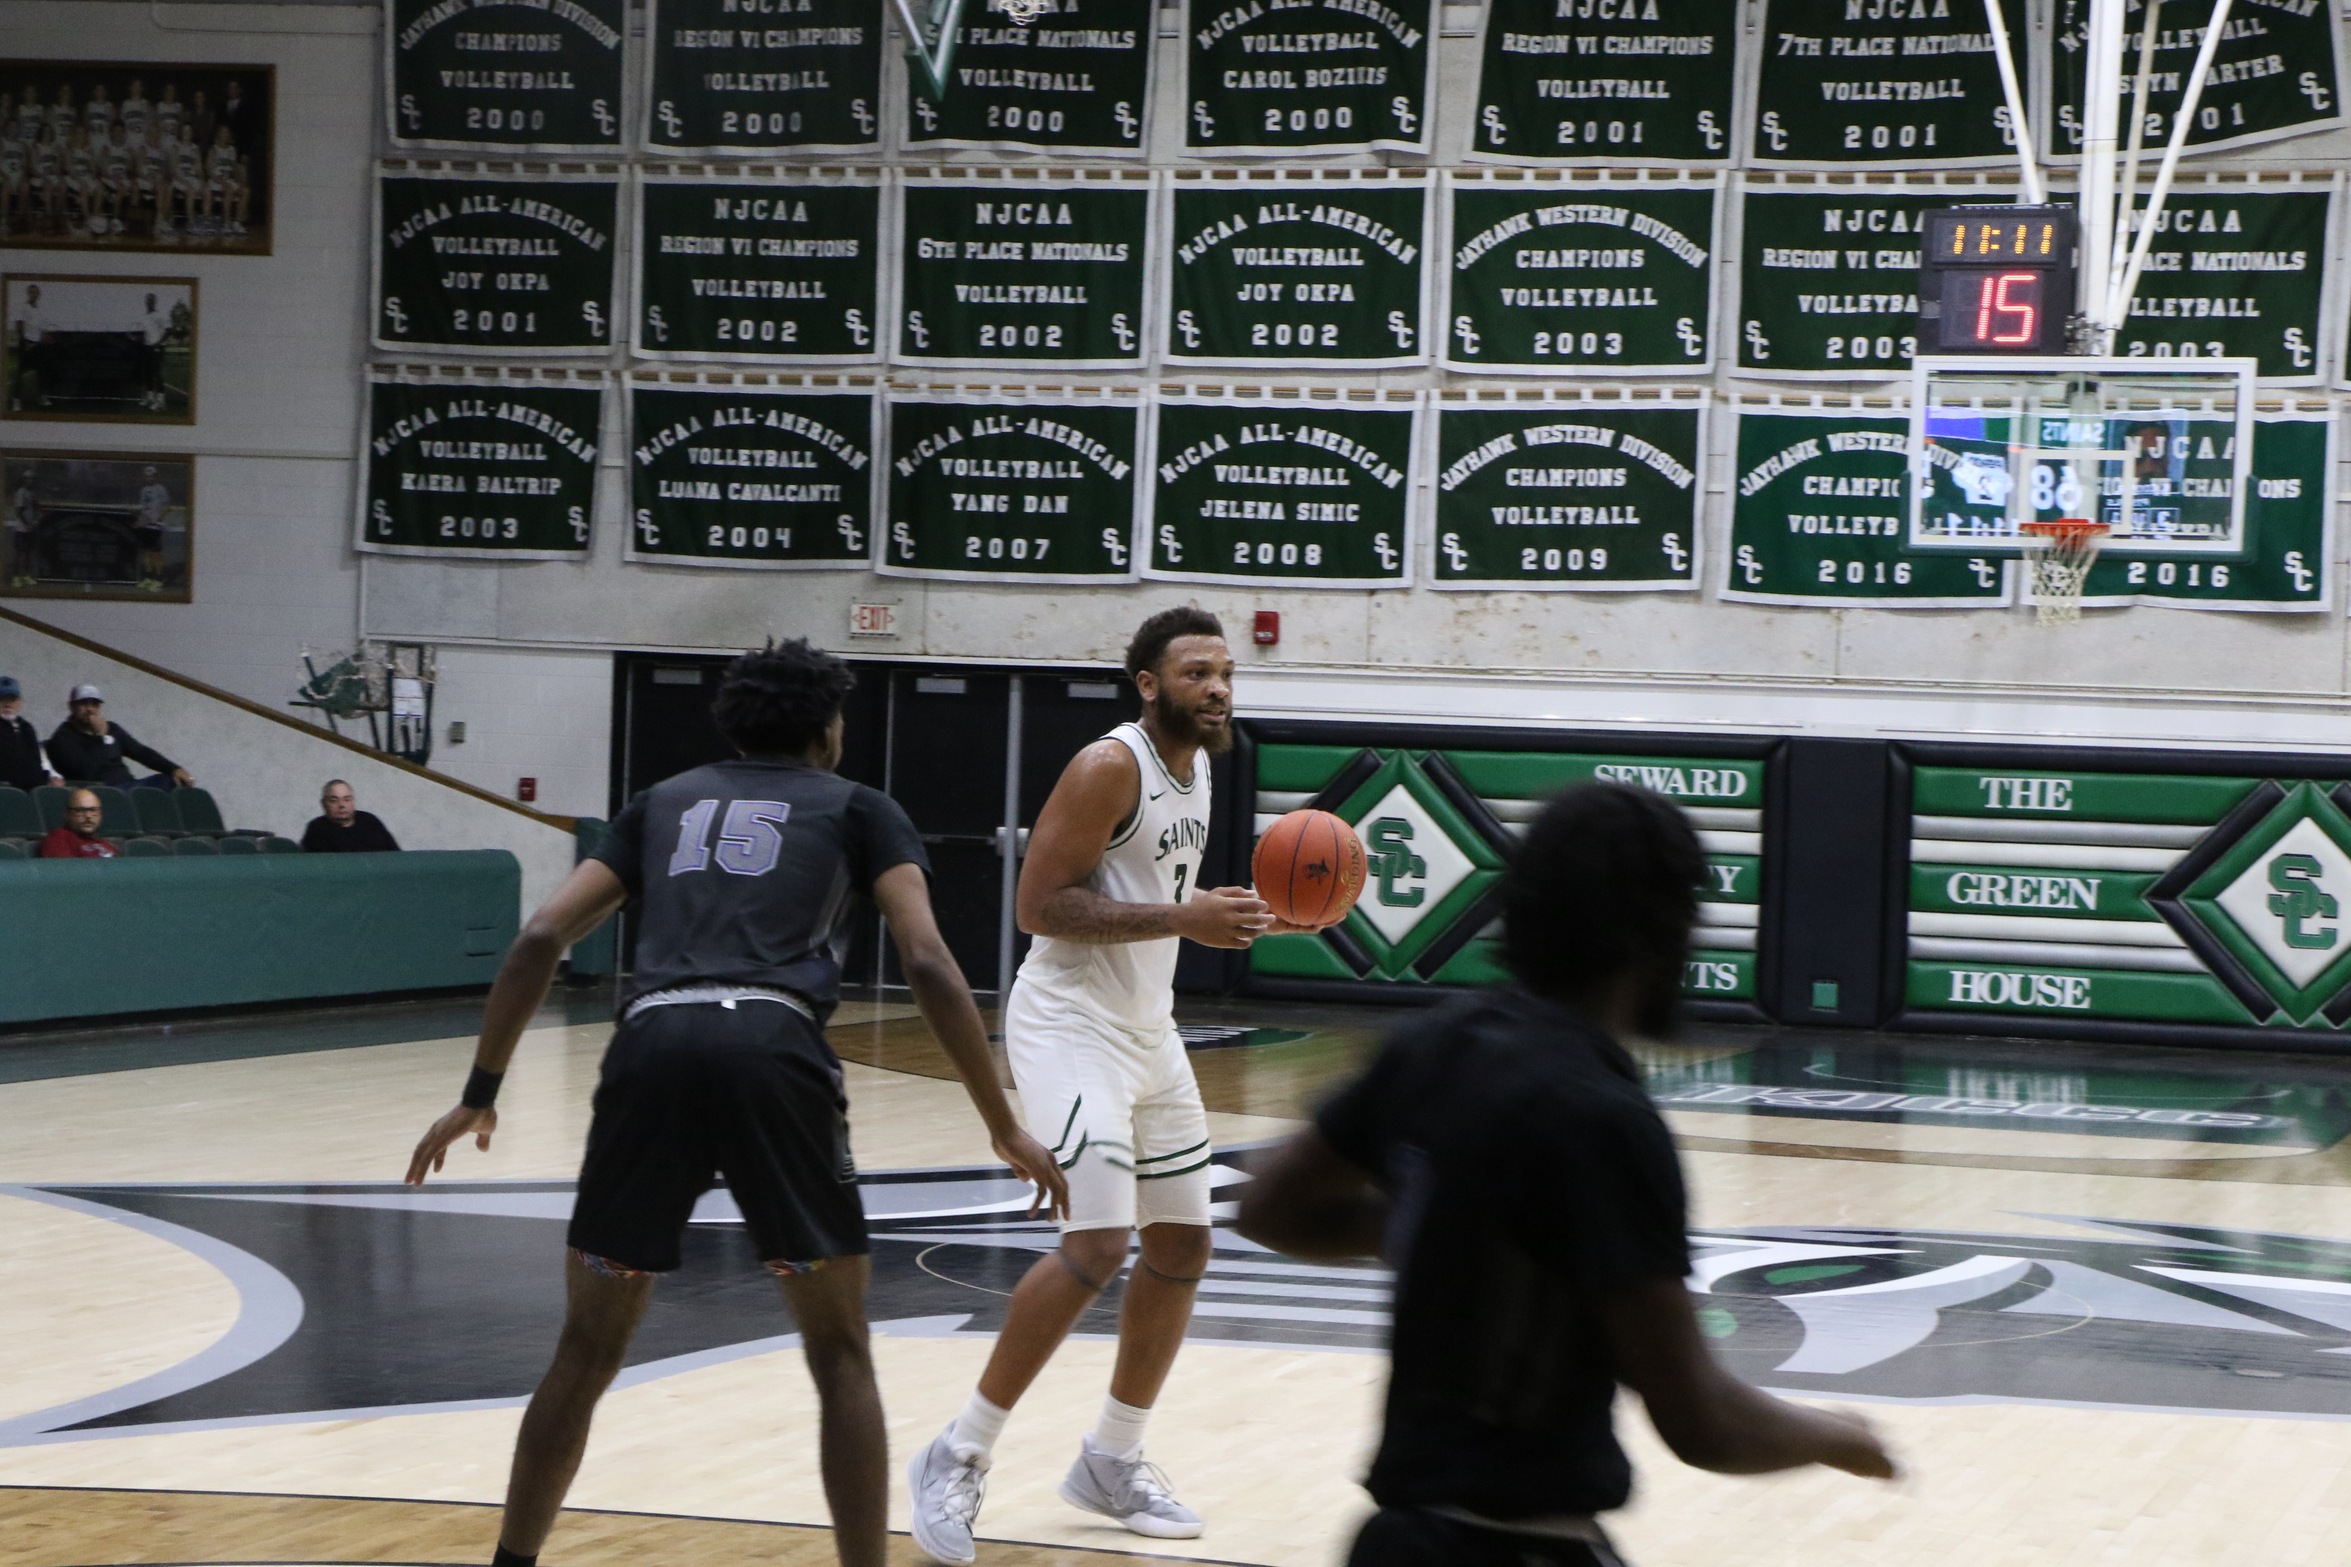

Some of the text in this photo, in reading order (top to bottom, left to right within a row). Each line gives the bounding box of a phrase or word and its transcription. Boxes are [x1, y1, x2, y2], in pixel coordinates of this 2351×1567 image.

[1556, 0, 1659, 20] NJCAA
[1845, 0, 1949, 20] NJCAA
[1196, 1, 1264, 49] NJCAA
[455, 33, 562, 50] CHAMPIONS
[674, 30, 734, 47] REGON
[765, 28, 863, 47] CHAMPIONS
[970, 28, 1028, 45] PLACE
[1037, 30, 1136, 48] NATIONALS
[1242, 32, 1379, 52] VOLLEYBALL
[1502, 33, 1714, 55] REGON VI CHAMPIONS
[1778, 32, 2010, 56] 7TH PLACE NATIONAL
[440, 71, 574, 89] VOLLEYBALL
[960, 69, 1094, 91] VOLLEYBALL
[1223, 70, 1297, 88] CAROL
[2205, 54, 2285, 86] ARTER
[1537, 80, 1670, 99] VOLLEYBALL
[1821, 79, 1965, 100] VOLLEYBALL
[467, 108, 544, 130] 2000
[722, 111, 801, 133] 2000
[988, 106, 1064, 132] 2000
[1265, 107, 1352, 131] 2000
[2145, 103, 2245, 136] 201
[1558, 121, 1643, 143] 2001
[1845, 124, 1936, 148] 2001
[715, 199, 808, 222] NJCAA
[976, 203, 1072, 224] NJCAA
[390, 195, 606, 251] NJCAA ALL-AMERICAN
[1178, 203, 1417, 265] NJCAA ALL-AMERICAN
[432, 236, 560, 255] VOLLEYBALL
[661, 235, 859, 257] REGION VI CHAMPIONS
[1456, 204, 1709, 270] JAYHAWK WESTERN DIVISION
[1953, 225, 2052, 254] 11:11
[918, 238, 1128, 261] 6TH PLACE NATIONALS
[1233, 248, 1364, 266] VOLLEYBALL
[1516, 249, 1644, 268] CHAMPIONS
[1762, 248, 1838, 268] REGION
[1846, 251, 1868, 269] VI
[2126, 251, 2307, 271] ACE NATIONALS
[442, 272, 549, 290] JOY OKPA
[692, 279, 826, 298] VOLLEYBALL
[955, 285, 1088, 303] VOLLEYBALL
[1237, 284, 1355, 301] JOY OKPA
[1501, 288, 1658, 306] VOLLEYBALL
[1798, 294, 1919, 314] VOLLEYBA
[1977, 275, 2037, 342] 15
[2130, 297, 2260, 317] LLEYBALL
[453, 309, 536, 332] 2001
[717, 318, 797, 342] 2002
[980, 325, 1062, 347] 2002
[1252, 324, 1339, 346] 2002
[1534, 332, 1623, 355] 2003
[1826, 337, 1918, 359] 2003
[2129, 341, 2225, 357] 2003
[373, 400, 598, 463] NJCAA ALL-AMERICAN
[635, 407, 869, 470] NJCAA ALL-AMERICAN
[420, 440, 547, 461] VOLLEYBALL
[688, 447, 818, 468] VOLLEYBALL
[896, 415, 1130, 480] NJCAA ALL-AMERICAN
[1159, 423, 1404, 489] NJCAA ALL-AMERICAN
[1441, 424, 1695, 491] JAYHAWK WESTERN DIVISION
[940, 458, 1084, 479] VOLLEYBALL
[1740, 431, 1908, 496] JAYHAWK WESTER
[477, 476, 562, 495] BALTRIP
[1214, 465, 1350, 486] VOLLEYBALL
[1506, 468, 1627, 487] CHAMPIONS
[659, 480, 842, 502] LUANA CAVALCANTI
[1803, 476, 1900, 498] CHAMPI
[951, 493, 1068, 513] YANG DAN
[1200, 500, 1360, 522] JELENA SIMIC
[1492, 506, 1640, 525] VOLLEYBALL
[1788, 515, 1898, 536] VOLLEYB
[440, 516, 519, 539] 2003
[708, 525, 791, 548] 2004
[966, 536, 1050, 560] 2007
[1234, 542, 1322, 565] 2008
[1522, 548, 1607, 570] 2009
[1818, 560, 1912, 585] 2016
[2128, 562, 2229, 588] 2016
[859, 607, 889, 630] EXIT
[1595, 764, 1748, 797] SEWARD
[1979, 777, 2073, 810] THE
[669, 800, 790, 877] 15
[1155, 818, 1205, 861] SAINTS
[1946, 872, 2101, 910] GREEN
[1948, 971, 2091, 1009] HOUSE
